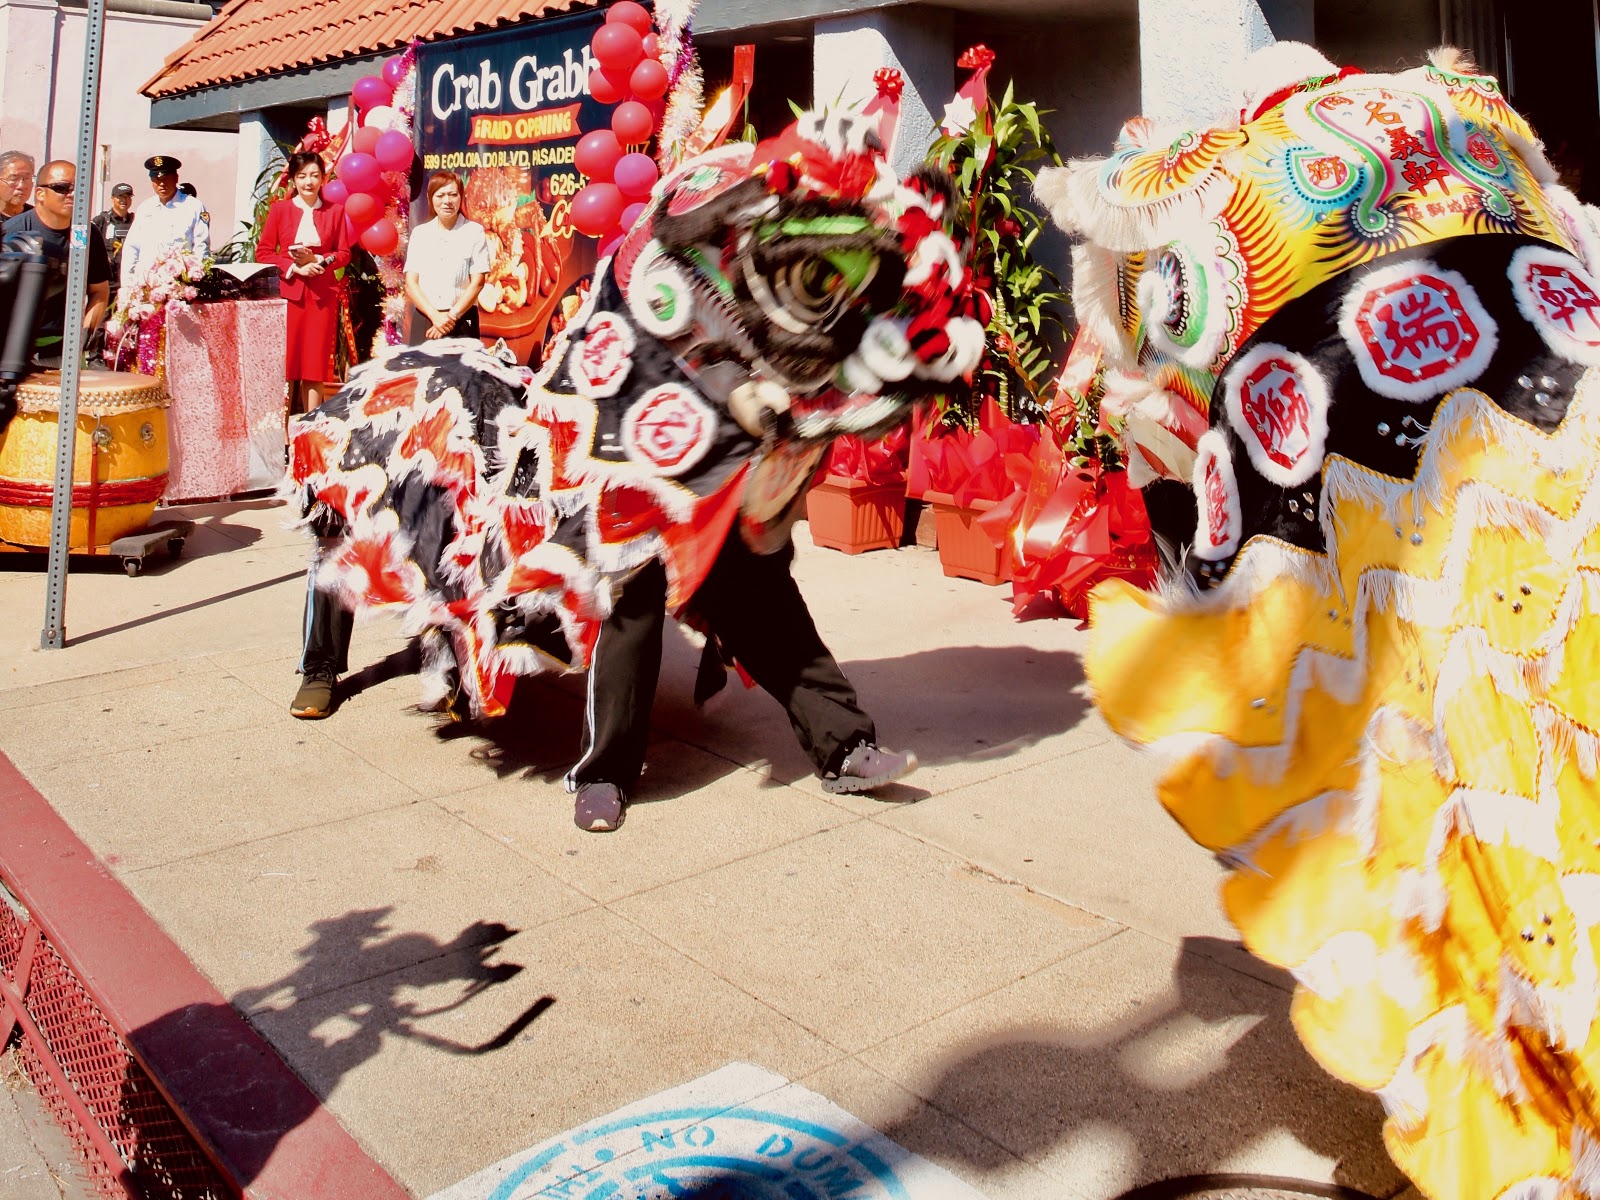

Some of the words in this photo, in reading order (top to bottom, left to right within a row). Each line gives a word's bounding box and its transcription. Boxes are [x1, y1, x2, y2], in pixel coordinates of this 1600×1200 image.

[431, 58, 501, 120] Crab
[515, 111, 571, 139] OPENING
[1374, 291, 1460, 361] 瑞
[641, 1125, 716, 1153] NO
[755, 1133, 876, 1200] DUM
